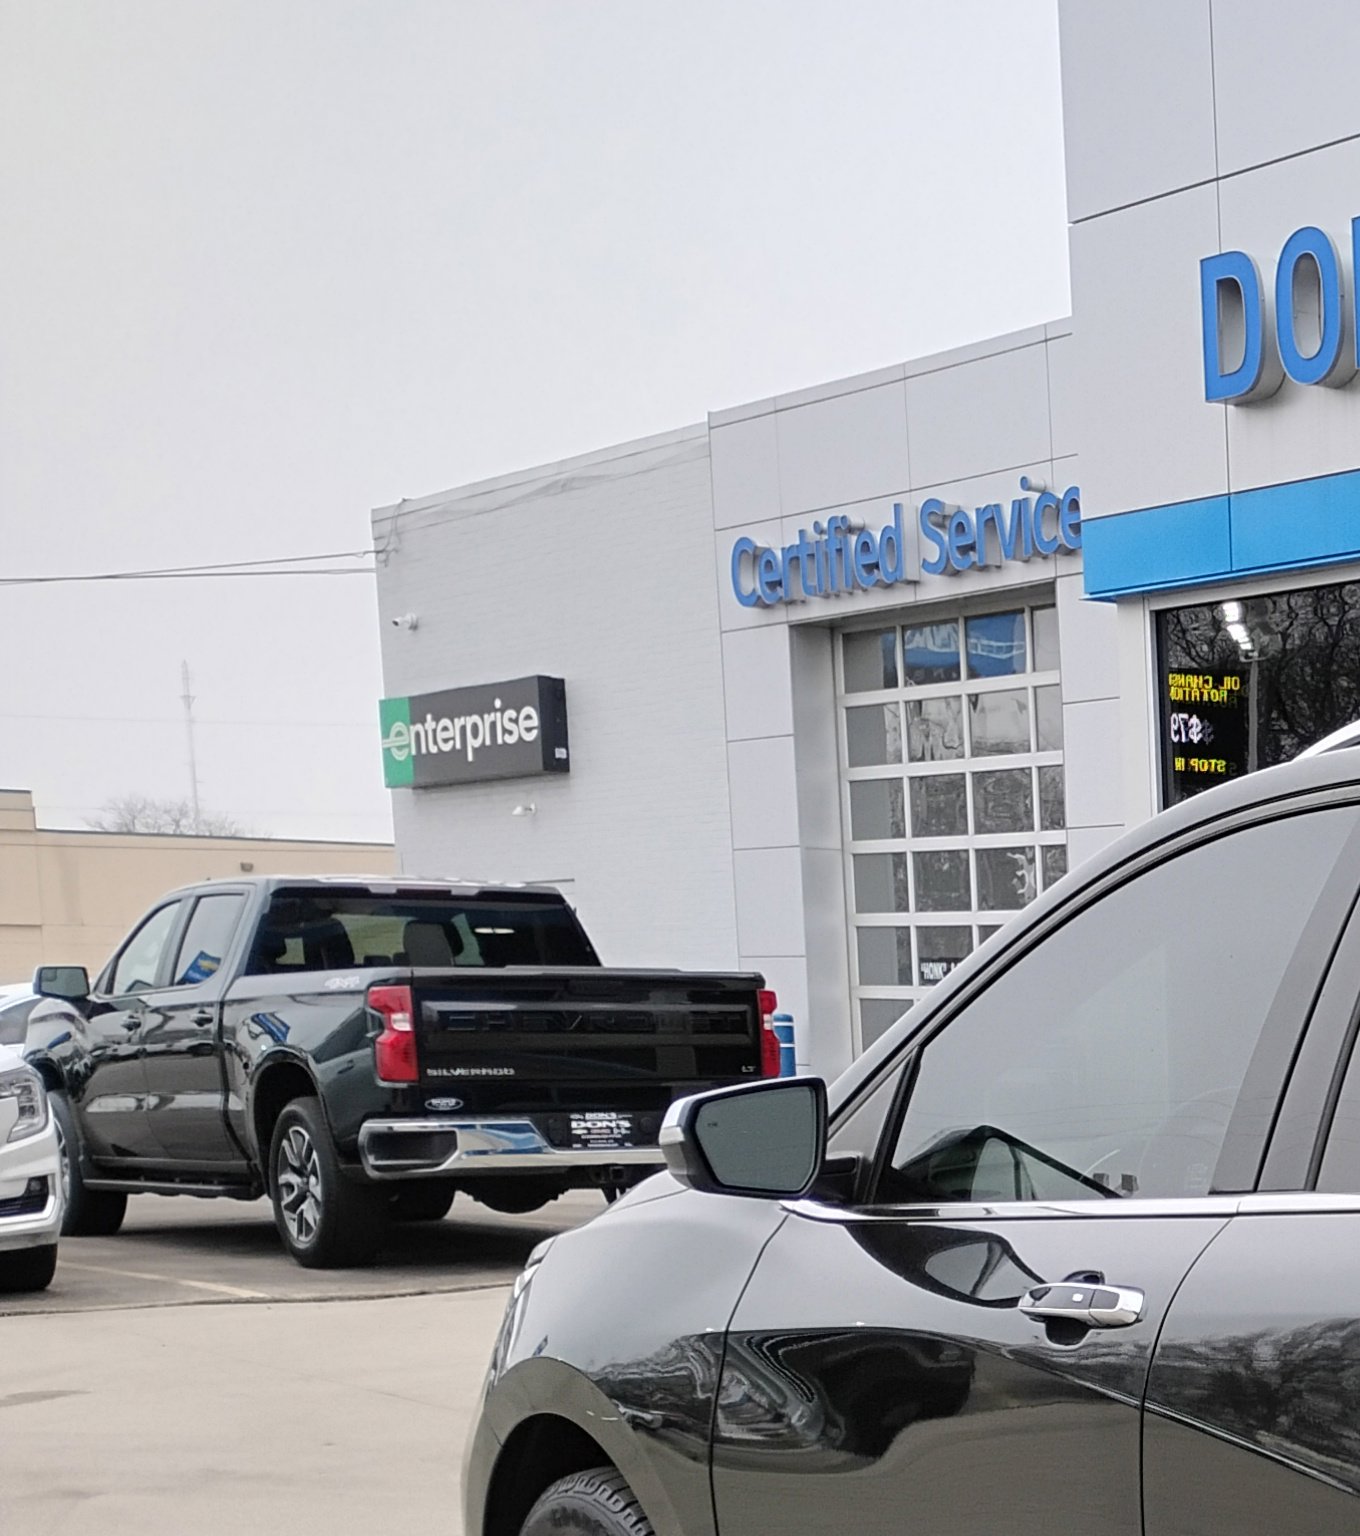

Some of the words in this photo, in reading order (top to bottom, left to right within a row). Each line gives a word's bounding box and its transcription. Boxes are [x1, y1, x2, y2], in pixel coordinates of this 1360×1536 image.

[731, 503, 908, 608] Certified
[920, 476, 1082, 577] Service
[382, 698, 539, 762] enterprise
[426, 1067, 515, 1077] SILVERADO
